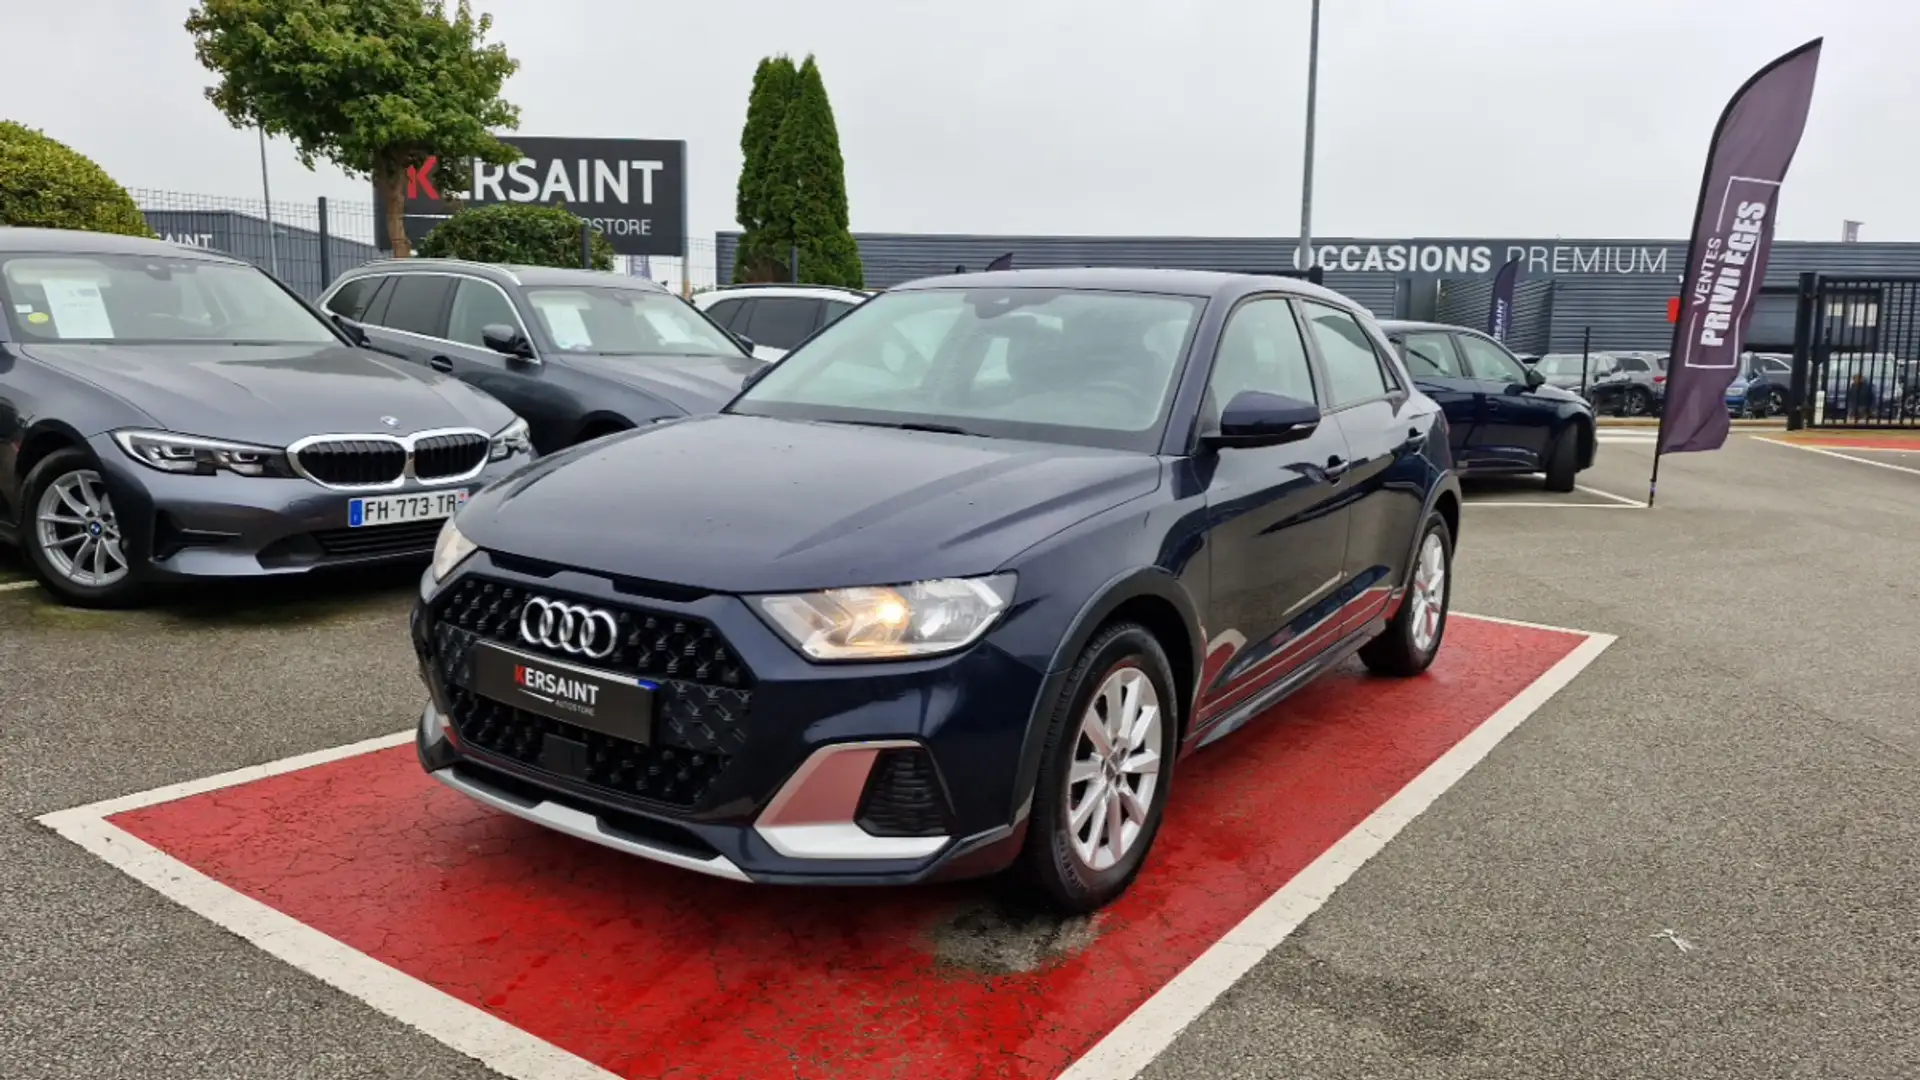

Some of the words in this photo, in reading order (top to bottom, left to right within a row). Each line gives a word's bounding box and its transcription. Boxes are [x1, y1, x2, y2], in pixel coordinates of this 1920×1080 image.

[406, 154, 664, 204] KRSAINT
[155, 232, 213, 250] AINT
[1506, 246, 1668, 273] PREMIUM
[1692, 236, 1722, 306] VENTES
[365, 494, 456, 521] FH-773-TR
[514, 664, 600, 705] KERSAINT
